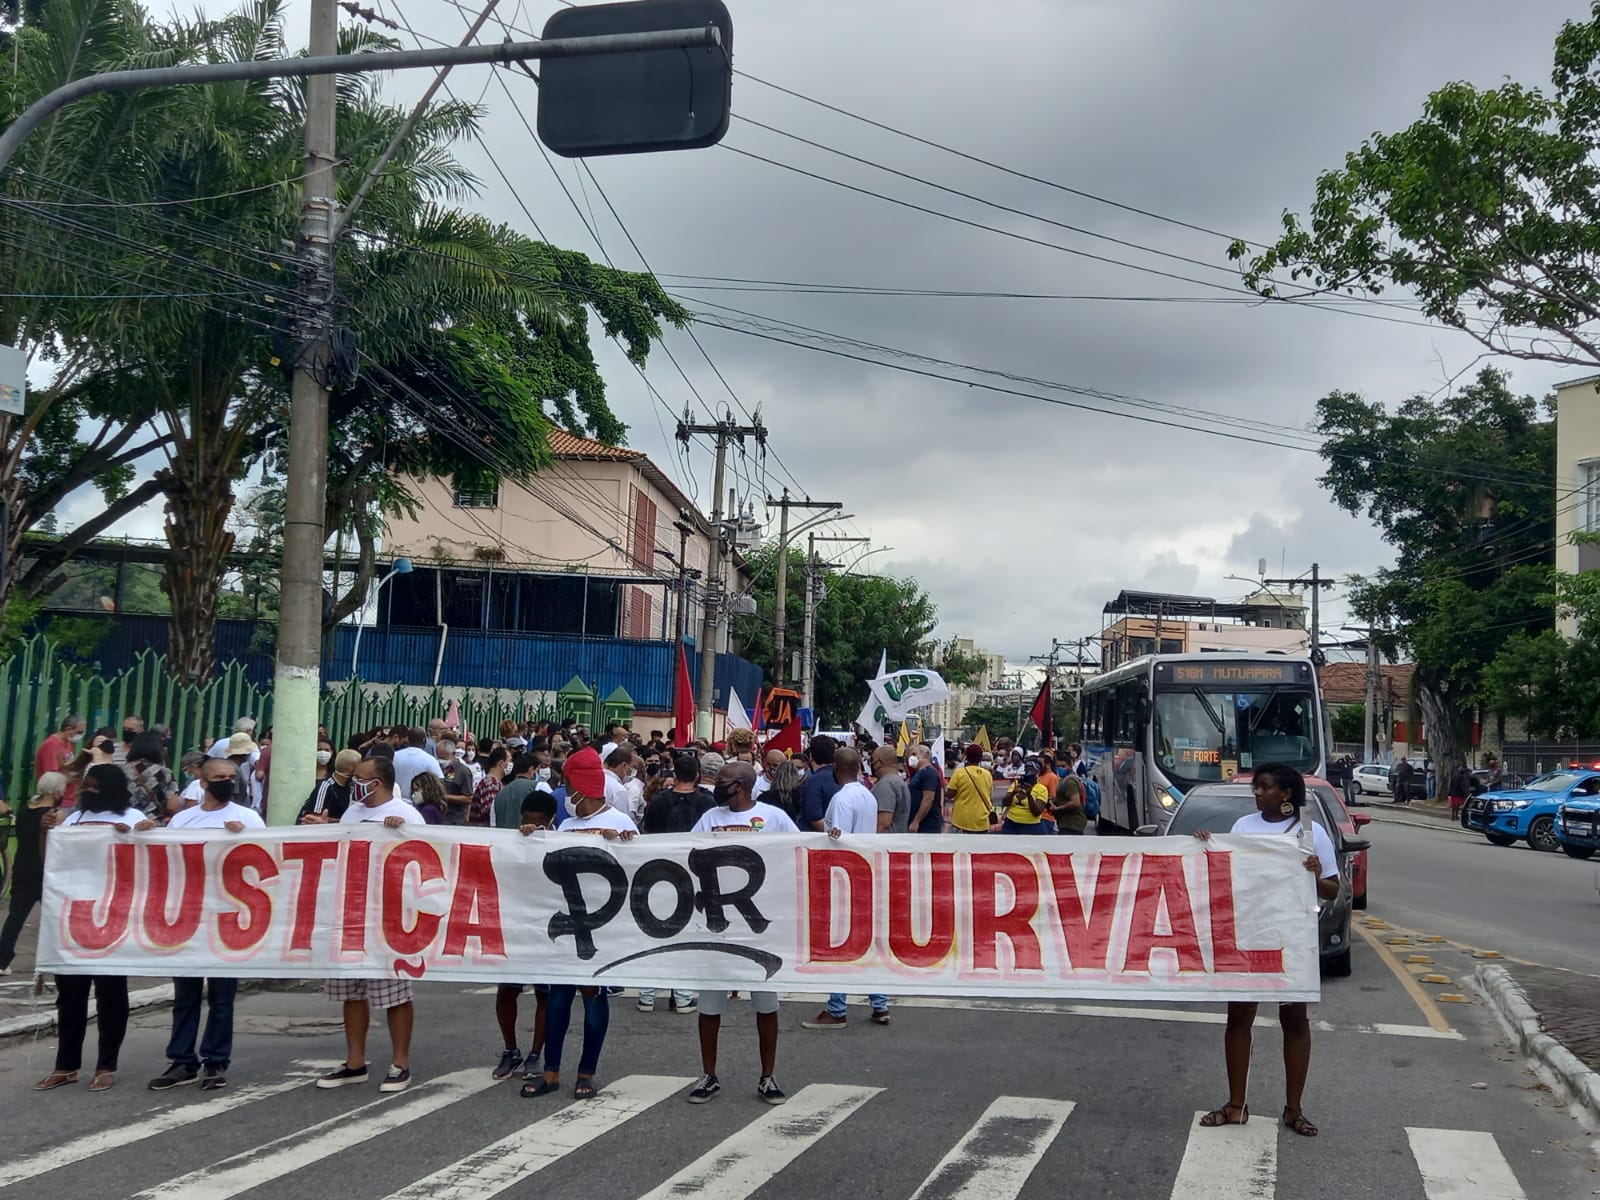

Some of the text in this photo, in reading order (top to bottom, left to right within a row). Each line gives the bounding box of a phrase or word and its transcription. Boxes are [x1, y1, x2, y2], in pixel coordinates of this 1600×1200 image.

[1213, 667, 1282, 679] MUTUAPIRA
[1193, 751, 1220, 763] FORTE
[68, 838, 1284, 978] JUSTIÇA POR DURVAL
